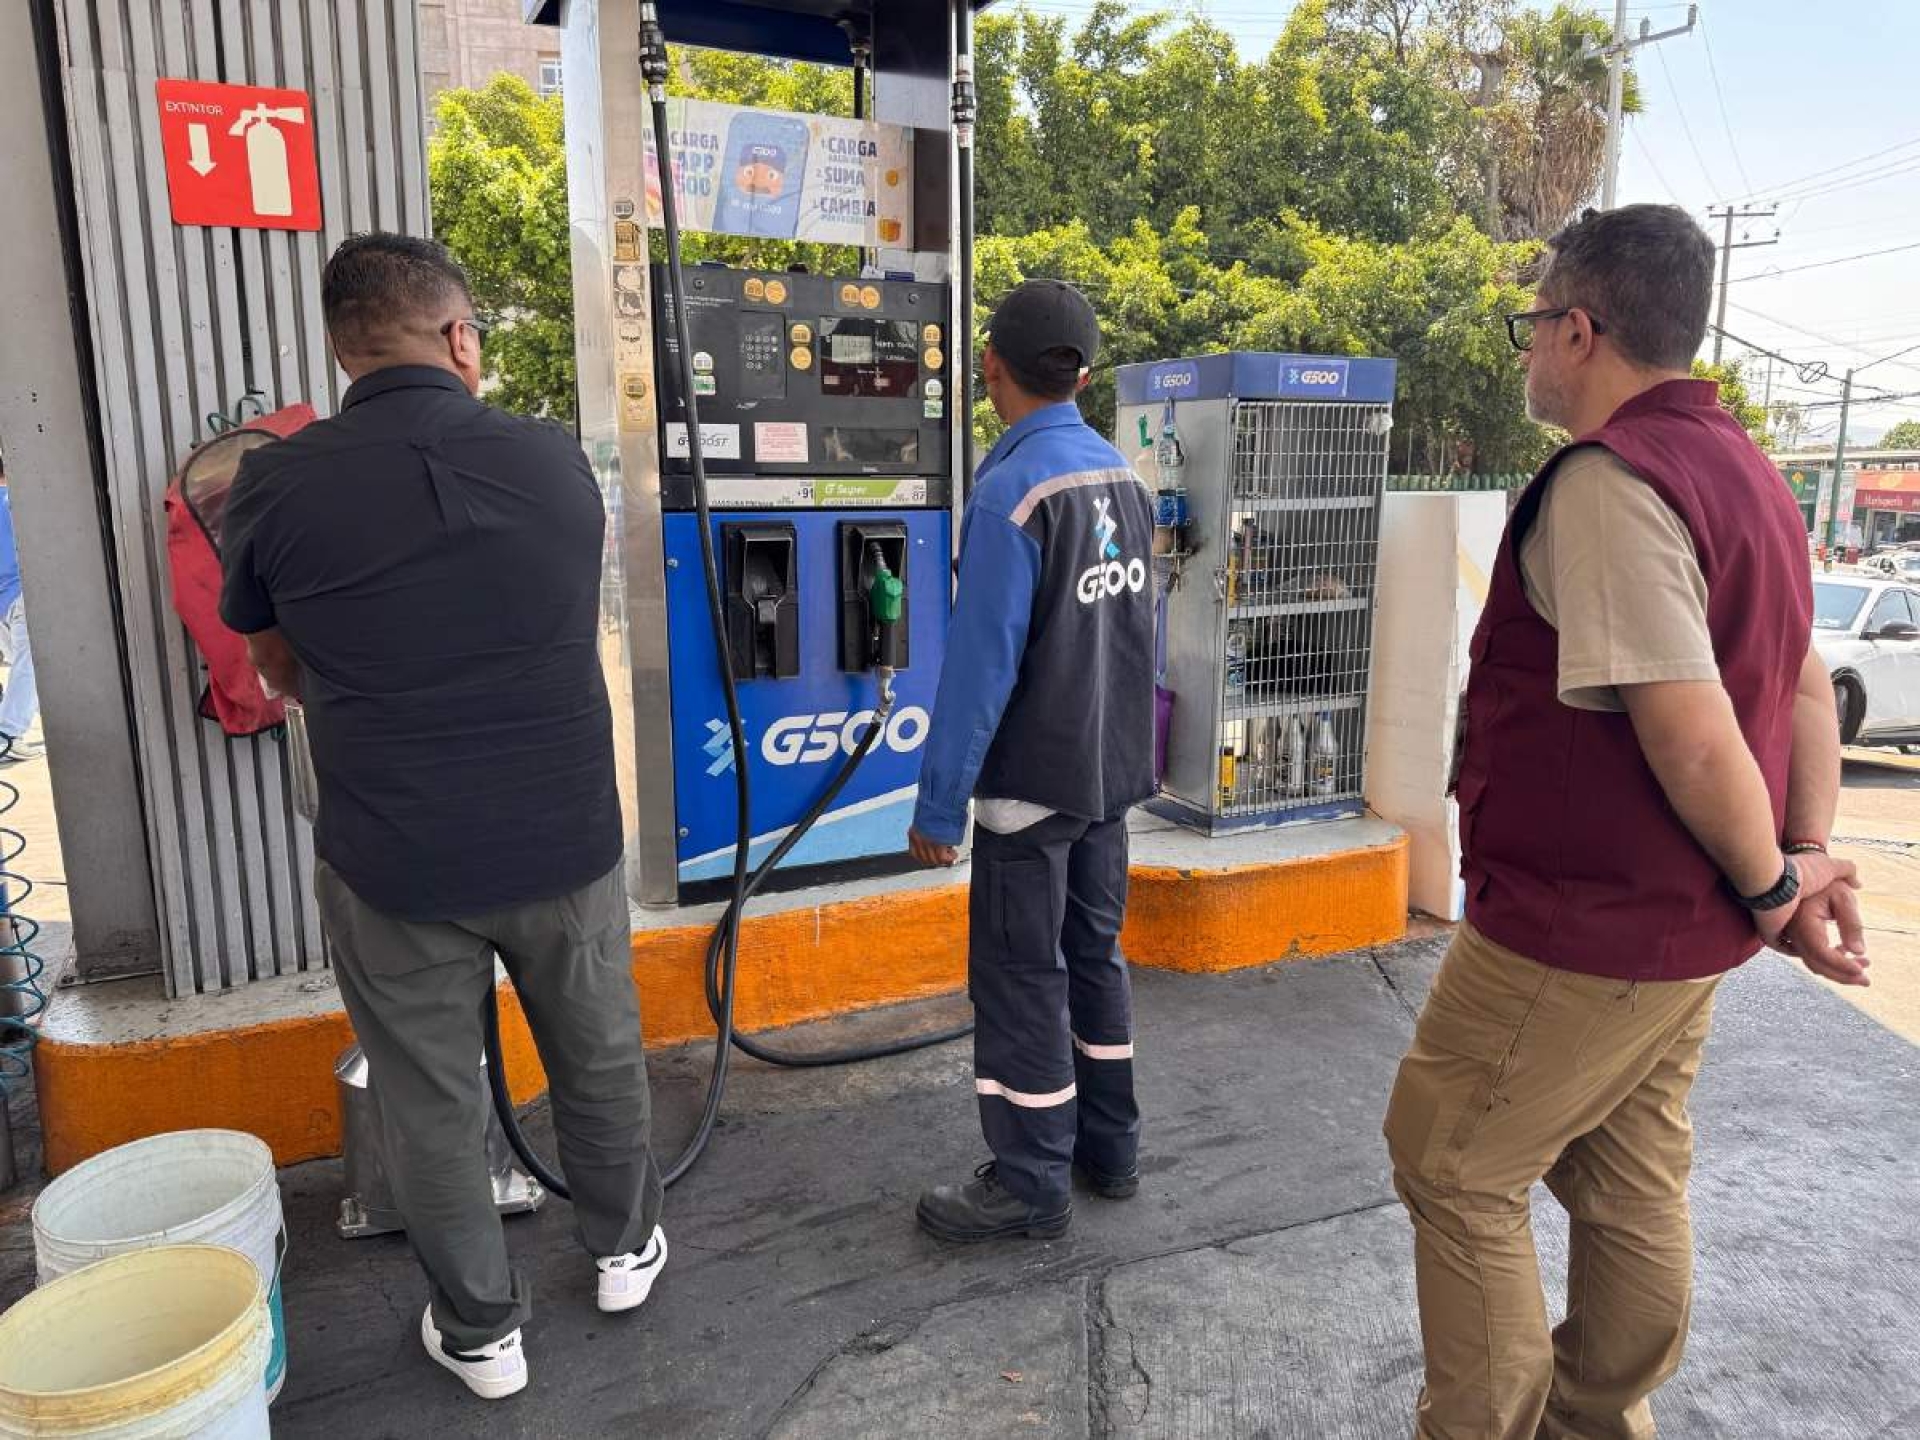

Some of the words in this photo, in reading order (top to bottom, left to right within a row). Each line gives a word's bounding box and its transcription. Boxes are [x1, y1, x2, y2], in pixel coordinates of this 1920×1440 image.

[164, 101, 224, 116] EXTINTOR
[828, 137, 877, 157] CARGA
[824, 166, 865, 187] SUMA
[820, 197, 876, 217] CAMBIA
[1163, 372, 1190, 388] G500
[1301, 370, 1339, 384] G500
[761, 706, 930, 765] G500
